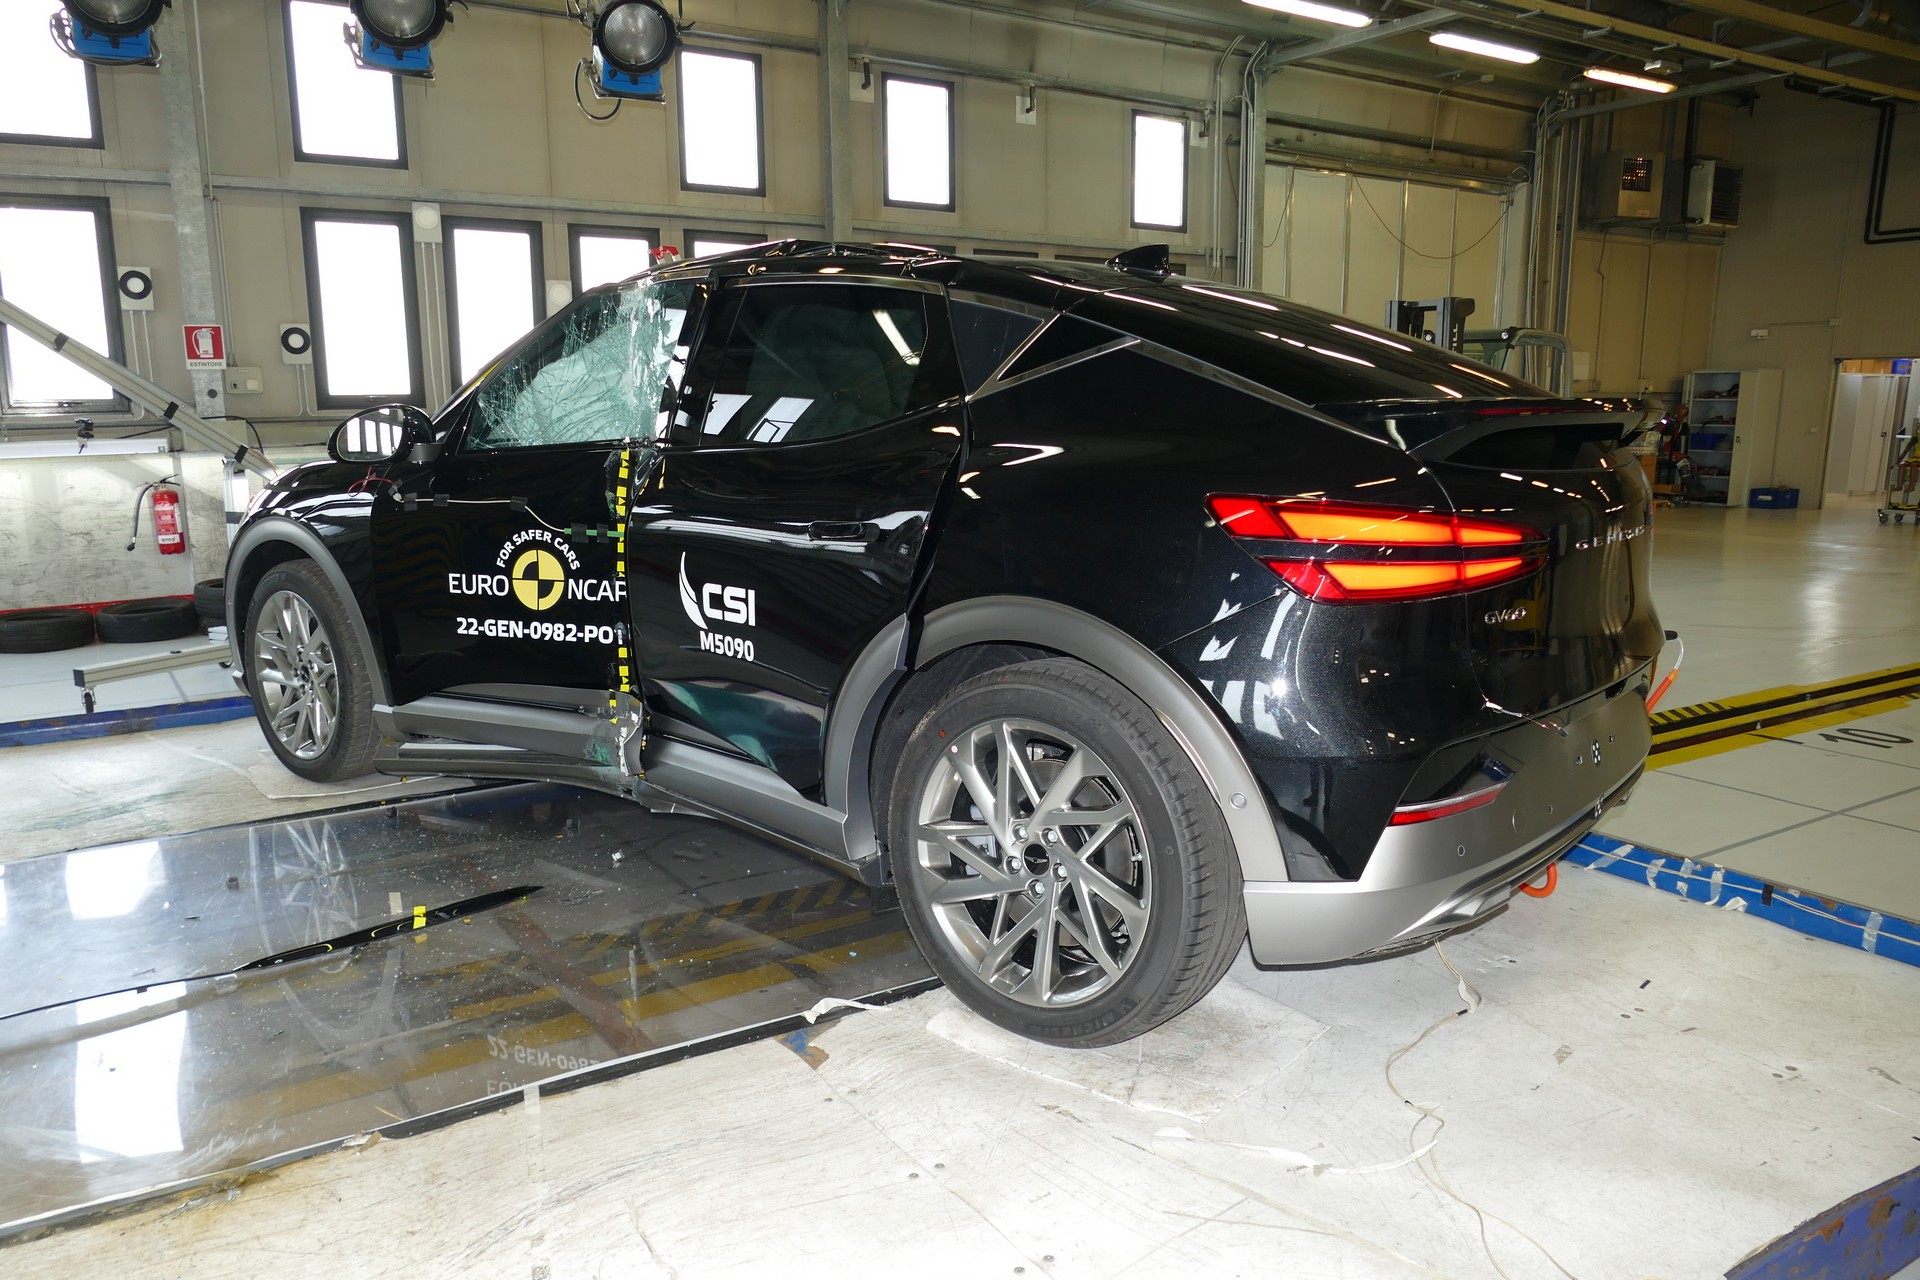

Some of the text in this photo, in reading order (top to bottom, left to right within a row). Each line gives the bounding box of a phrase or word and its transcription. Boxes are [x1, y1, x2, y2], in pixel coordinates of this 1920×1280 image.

[496, 529, 581, 570] FOR SAFER CARS
[448, 573, 627, 602] EURO NCAP
[702, 582, 756, 627] CSI
[1484, 606, 1527, 625] GV60
[699, 630, 754, 662] M5090
[1817, 727, 1914, 749] 10
